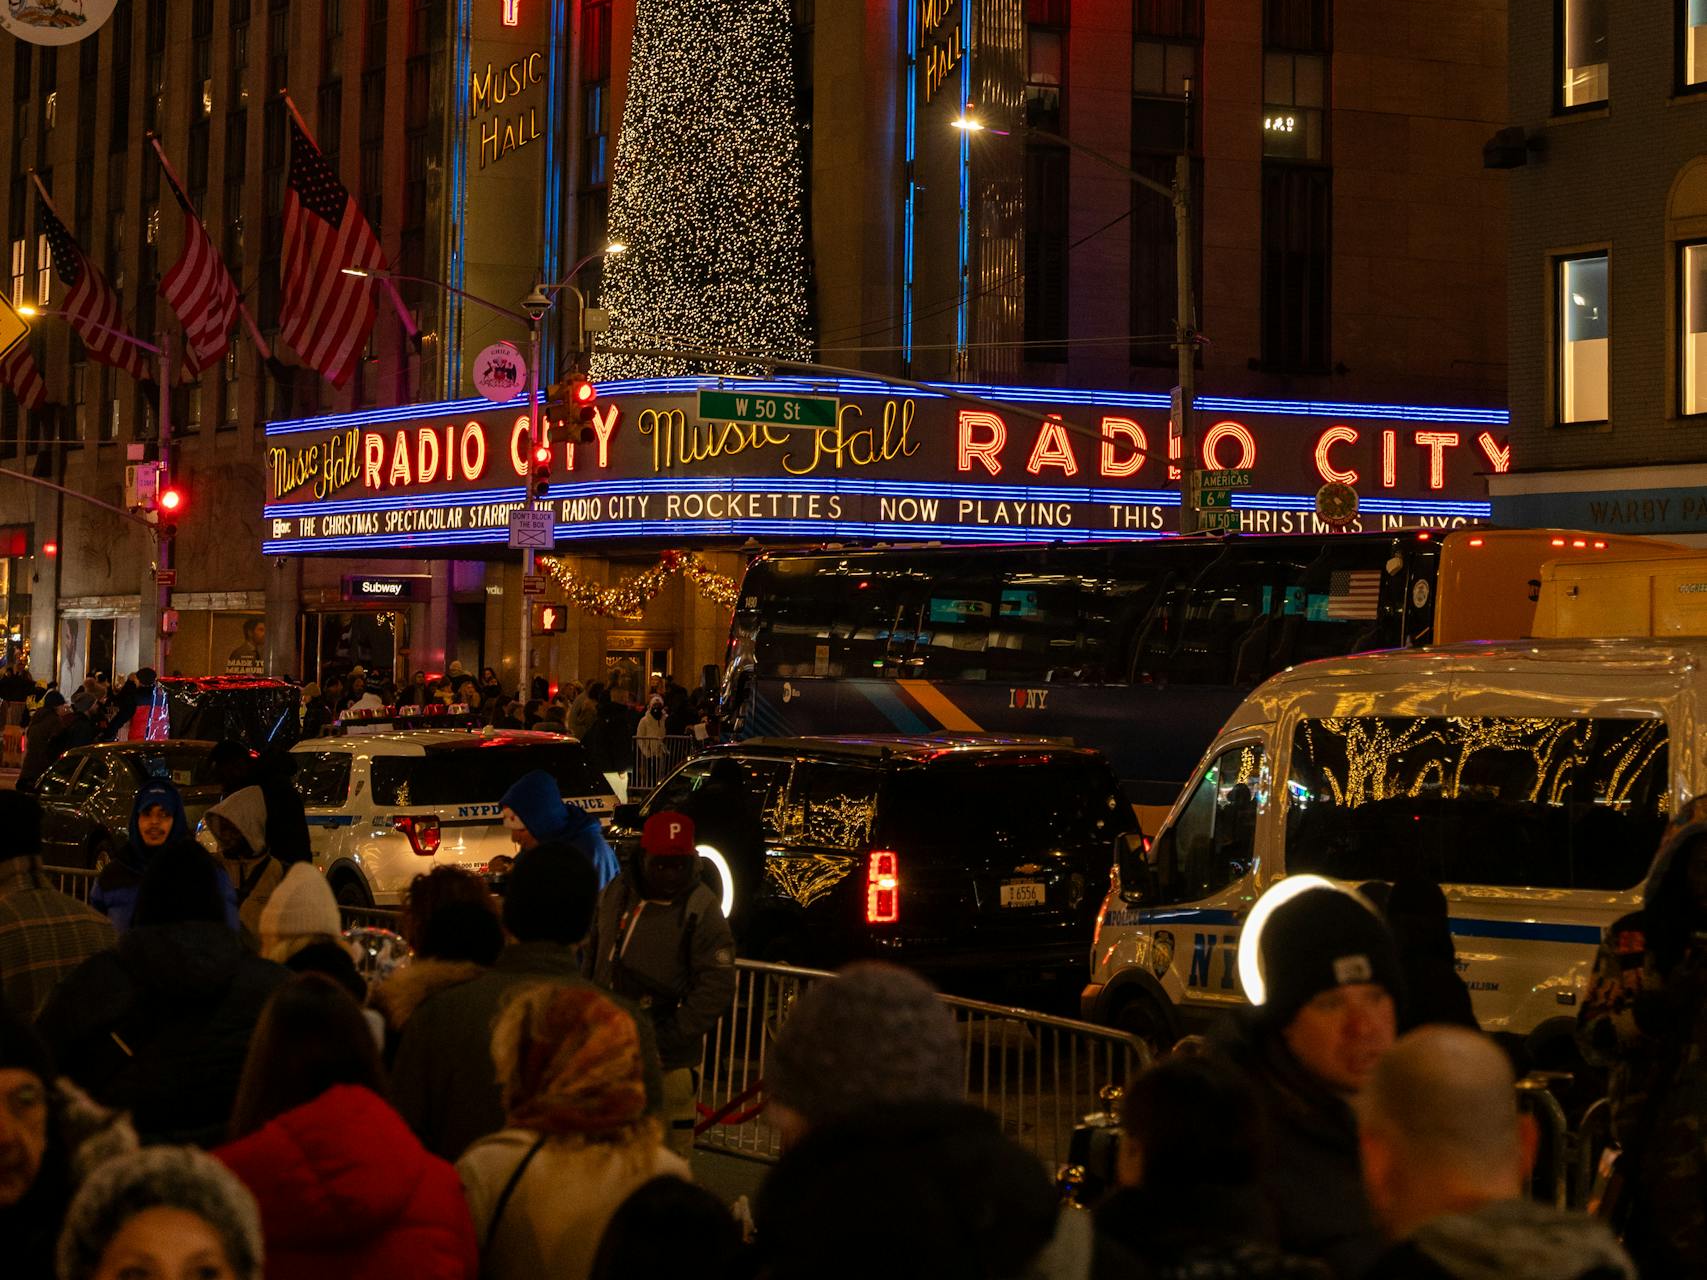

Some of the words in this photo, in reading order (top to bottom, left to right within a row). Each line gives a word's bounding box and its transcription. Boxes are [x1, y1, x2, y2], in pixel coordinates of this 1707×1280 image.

[925, 24, 963, 104] HALL
[471, 50, 543, 119] MUSIC
[480, 106, 543, 170] HALL
[735, 397, 749, 417] W
[754, 399, 777, 418] 50
[783, 401, 801, 421] St
[782, 398, 921, 475] Hall
[957, 408, 1257, 482] RADIO
[269, 446, 318, 499] Music
[313, 426, 361, 501] Hall
[363, 420, 486, 490] RADIO
[1203, 474, 1249, 487] AMERICAS
[1206, 492, 1215, 506] 6
[1590, 497, 1670, 524] WARBY
[299, 516, 317, 537] THE
[322, 512, 379, 537] CHRISTMAS
[384, 506, 463, 533] SPECTACULAR
[561, 496, 601, 522] RADIO
[608, 494, 649, 520] CITY
[667, 493, 843, 519] ROCKETTES
[879, 497, 940, 522] NOW
[958, 499, 1073, 527] PLAYING
[1109, 504, 1164, 529] THIS
[512, 512, 530, 520] DON'T
[1208, 514, 1217, 528] W
[1217, 514, 1230, 528] 50
[361, 581, 402, 596] Subway
[1026, 688, 1049, 710] NY
[458, 804, 502, 817] NYPD
[669, 822, 682, 840] P
